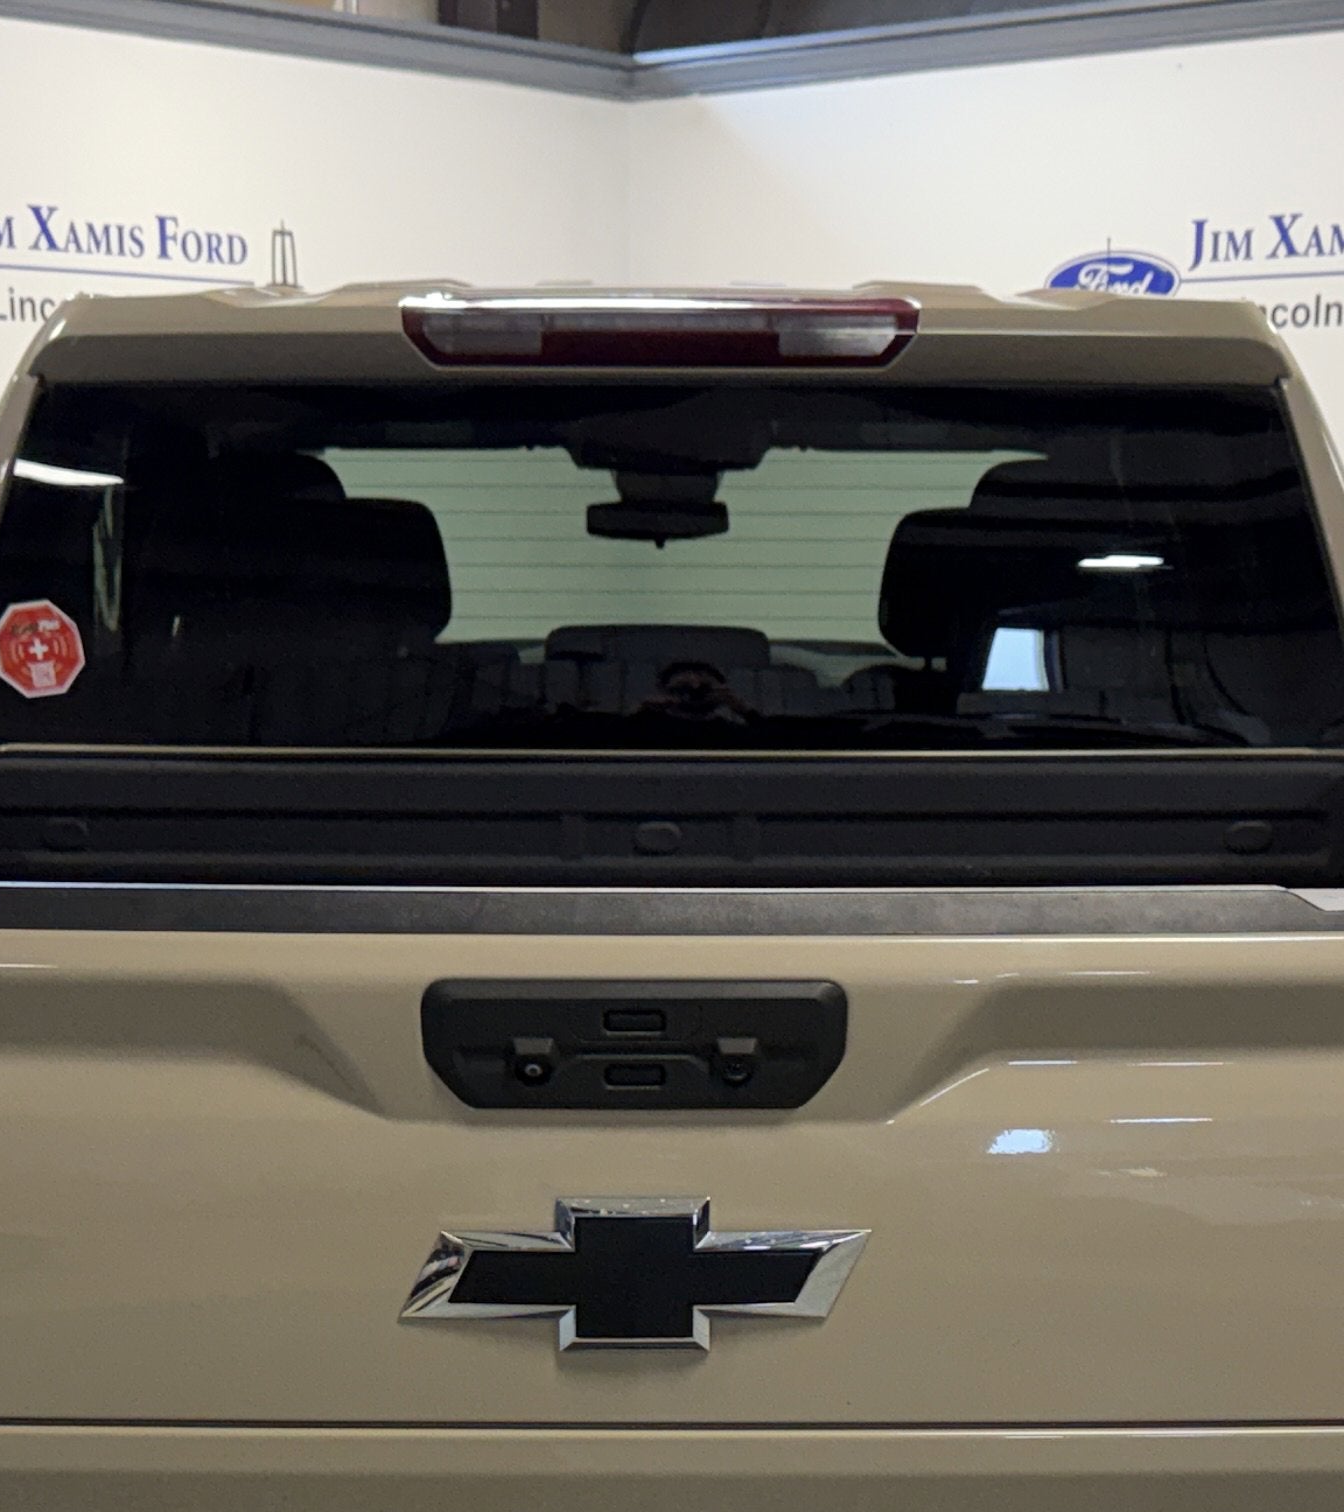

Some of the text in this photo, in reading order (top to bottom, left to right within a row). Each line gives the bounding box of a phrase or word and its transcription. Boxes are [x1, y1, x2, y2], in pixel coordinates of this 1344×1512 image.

[27, 205, 145, 258] XAMIS
[156, 215, 248, 265] FORD
[1189, 218, 1254, 271] JIM
